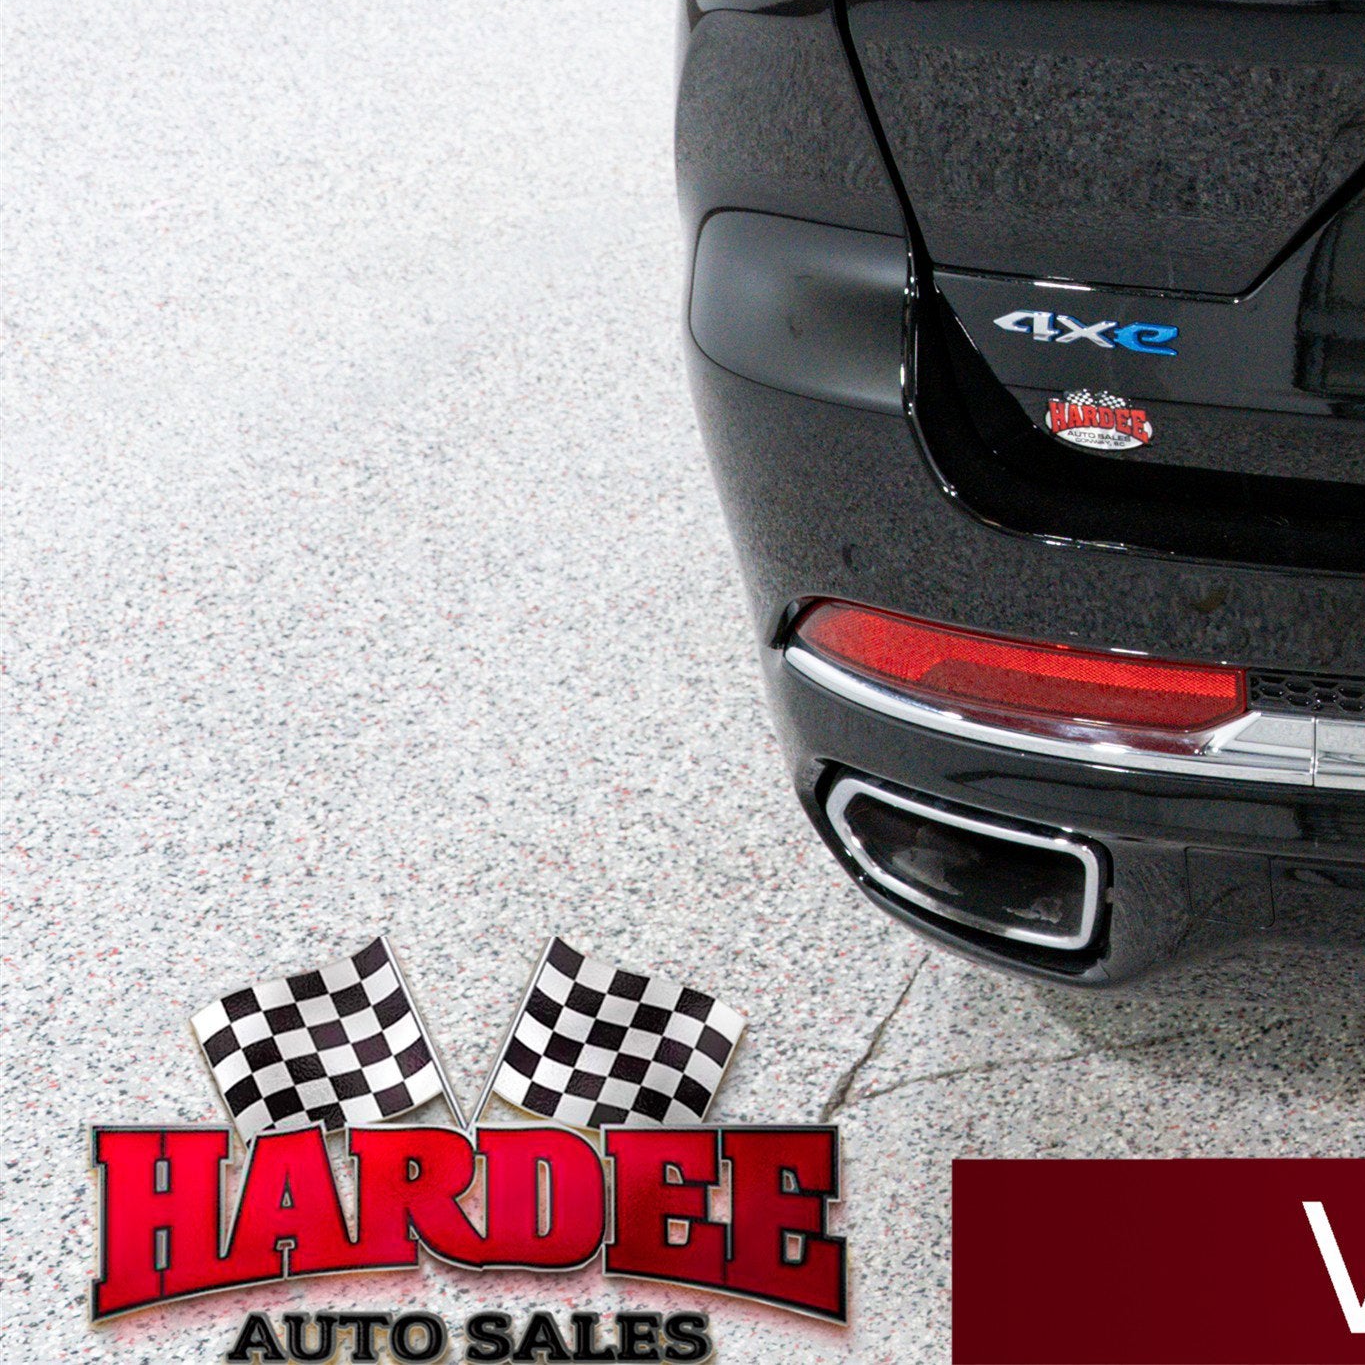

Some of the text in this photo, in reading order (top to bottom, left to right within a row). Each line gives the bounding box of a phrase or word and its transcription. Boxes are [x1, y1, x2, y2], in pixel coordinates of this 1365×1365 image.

[1048, 400, 1149, 444] HARDEE
[1067, 429, 1132, 443] AUTO SALES
